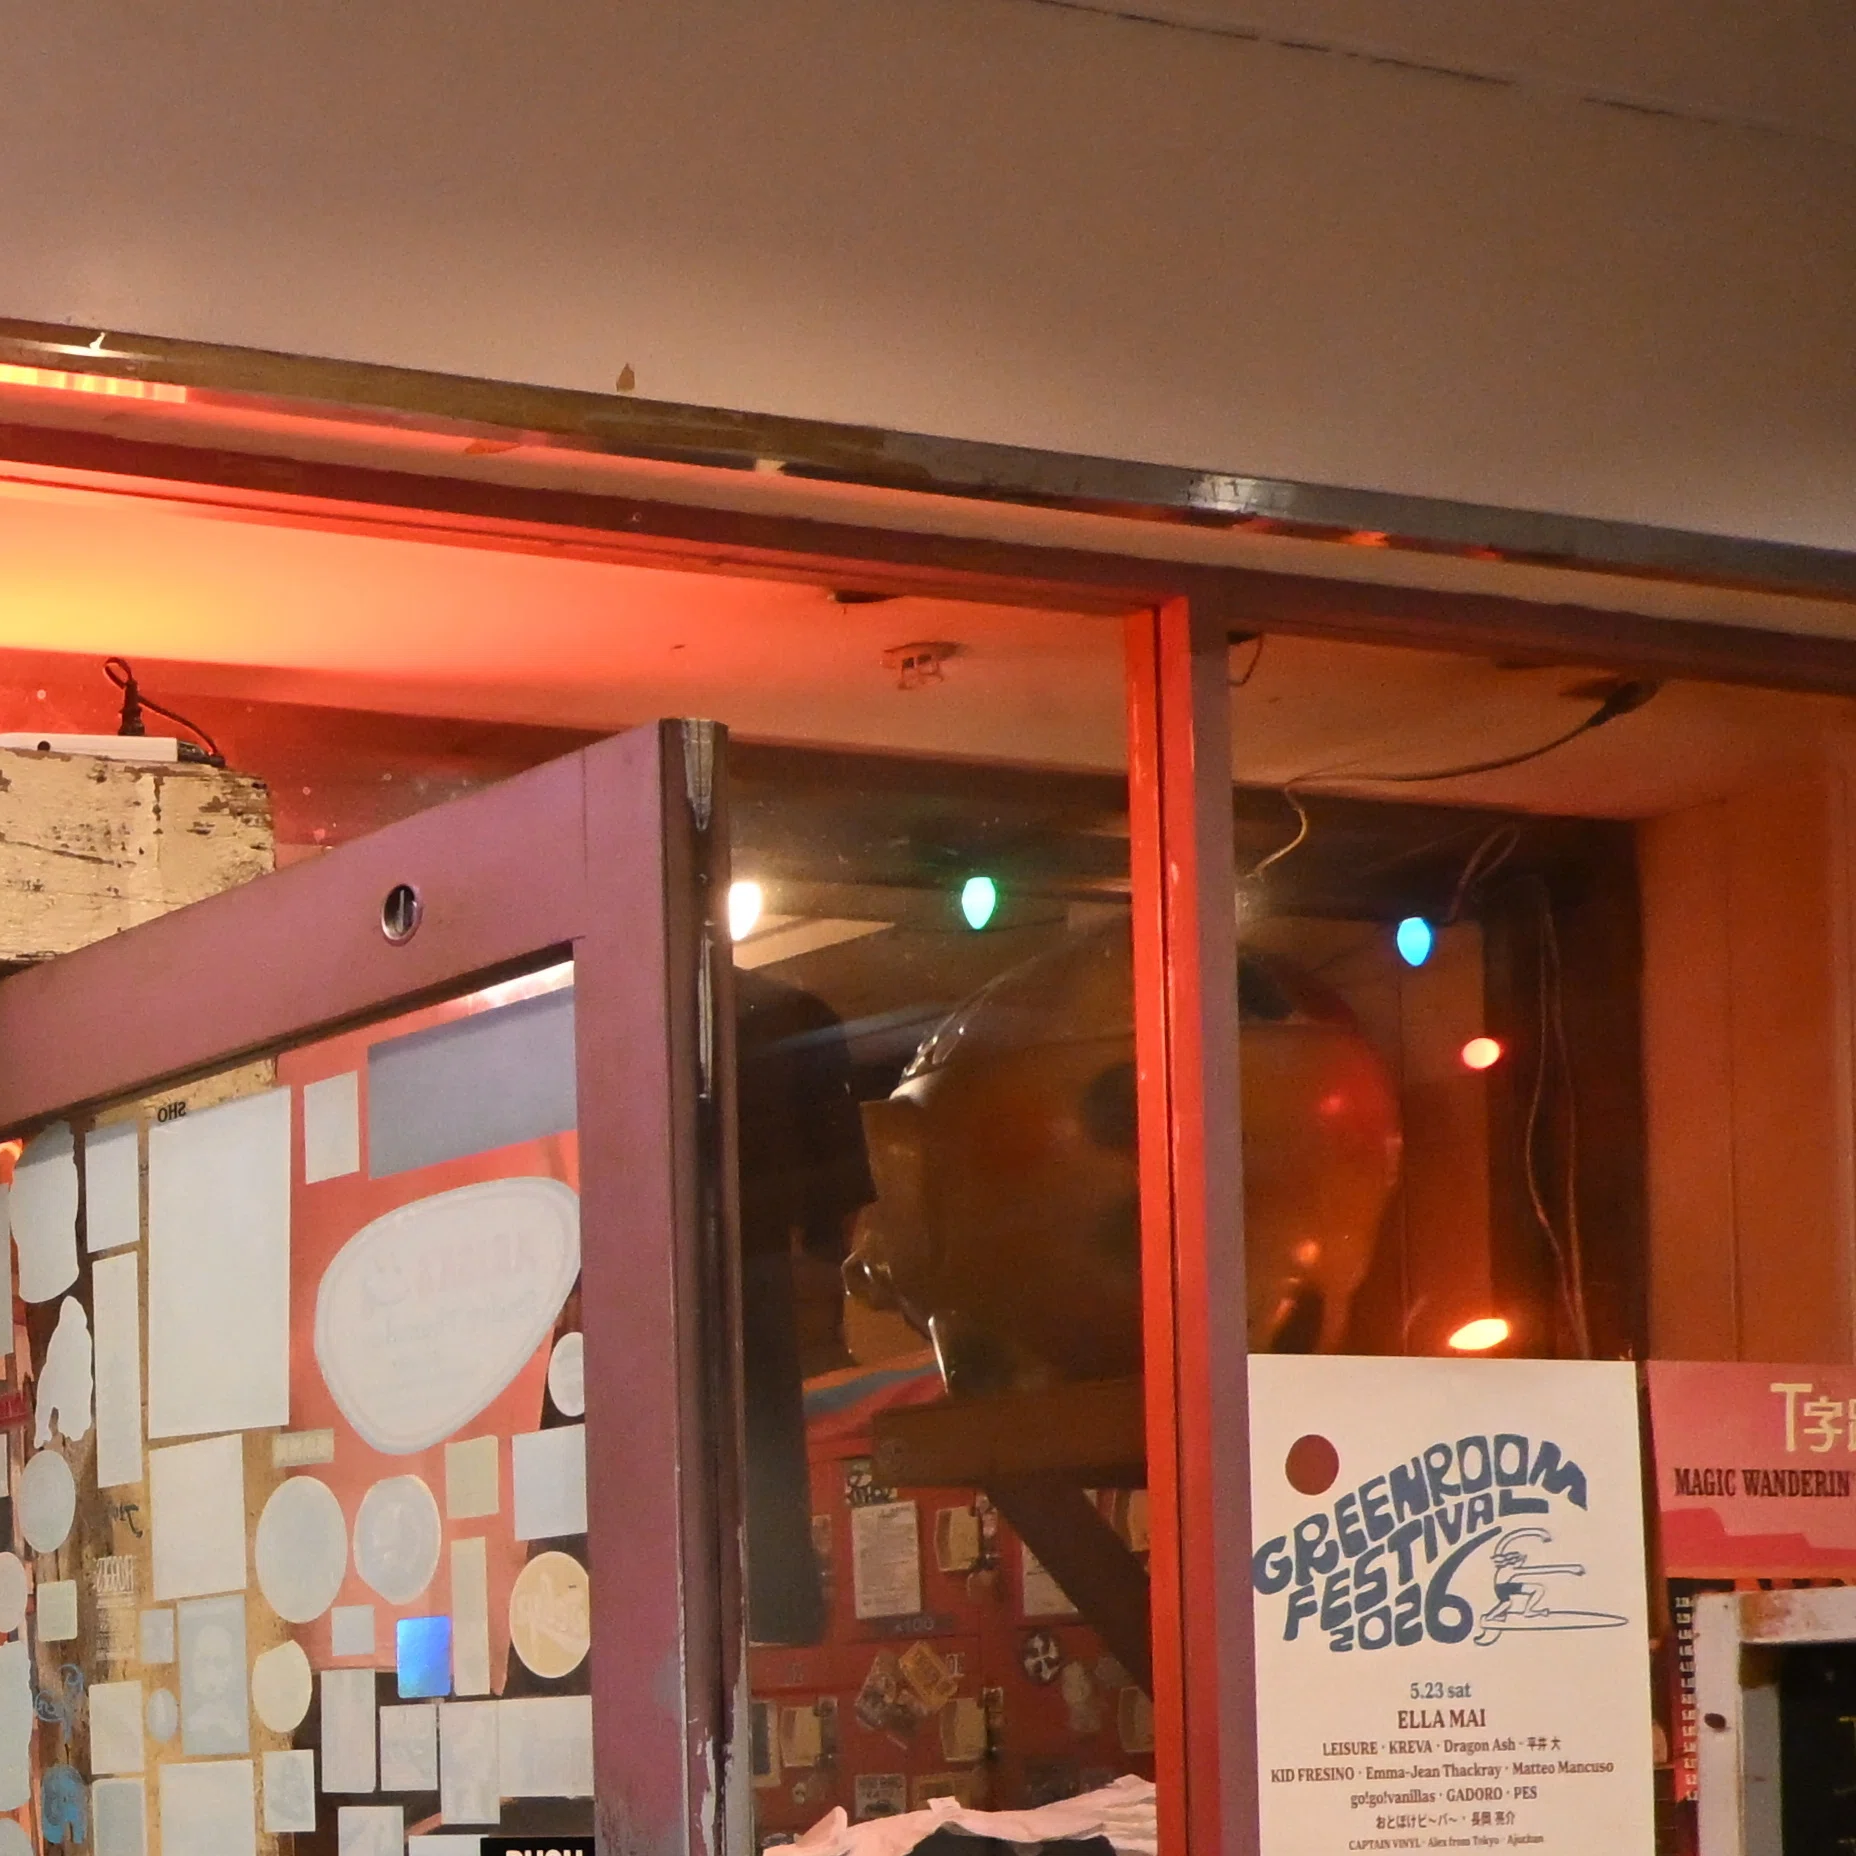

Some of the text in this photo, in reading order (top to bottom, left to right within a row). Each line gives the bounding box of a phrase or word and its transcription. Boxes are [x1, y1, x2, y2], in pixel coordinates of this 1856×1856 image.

[1770, 1383, 1856, 1452] T字
[1674, 1467, 1737, 1498] MAGIC
[1252, 1433, 1587, 1595] GREENROOM
[1283, 1488, 1549, 1642] FESTIVAL
[1329, 1526, 1503, 1653] 2026
[1410, 1682, 1472, 1700] 5.23 sat
[1398, 1709, 1486, 1729] ELLA MAI
[1271, 1761, 1614, 1783] KID FRESINO Emma-Jean Thackray Matteo Mancuso
[1446, 1787, 1503, 1802] GADORO
[1513, 1786, 1538, 1800] PES
